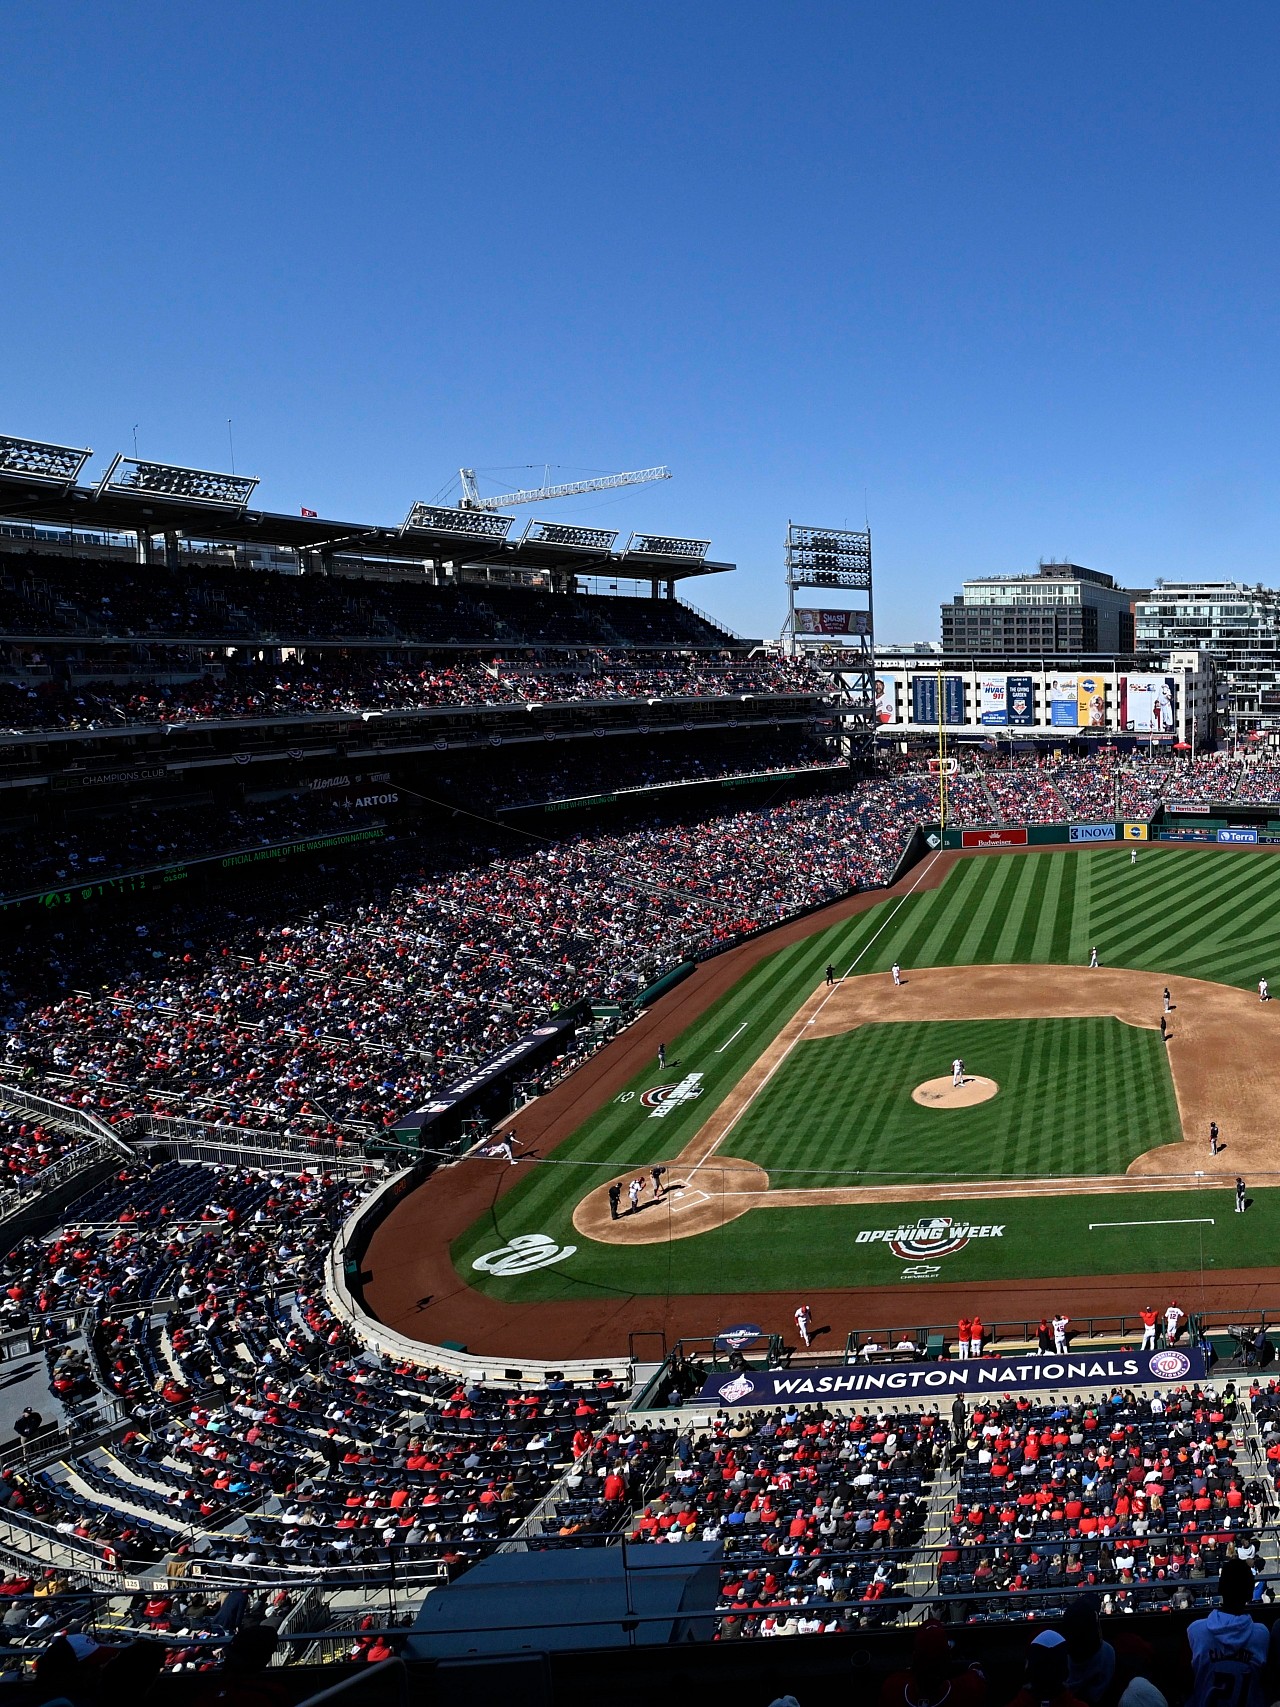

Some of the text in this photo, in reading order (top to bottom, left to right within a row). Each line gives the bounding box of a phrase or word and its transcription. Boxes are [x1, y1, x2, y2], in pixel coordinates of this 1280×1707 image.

[823, 613, 846, 624] SMASH
[82, 772, 139, 785] CHAMPIONS
[141, 769, 165, 778] CLUB
[355, 793, 399, 808] ARTOIS
[558, 802, 570, 810] FREE
[587, 797, 606, 806] ROLLING
[1081, 829, 1114, 838] INOVA
[1230, 833, 1254, 841] Terra
[222, 854, 253, 868] OFFICIAL
[254, 848, 282, 861] AIRLINE
[283, 847, 292, 856] OF
[293, 844, 306, 853] THE
[306, 836, 350, 850] WASHINGTON
[163, 872, 188, 883] OLSON
[64, 893, 71, 903] 3
[449, 1041, 536, 1094] NATIONALS PARK
[855, 1225, 1007, 1243] OPENING WEEK
[1169, 1313, 1178, 1321] 12
[773, 1369, 969, 1395] WASHINGTON
[978, 1359, 1139, 1384] NATIONALS
[782, 1481, 789, 1491] 11
[127, 1581, 138, 1589] 125
